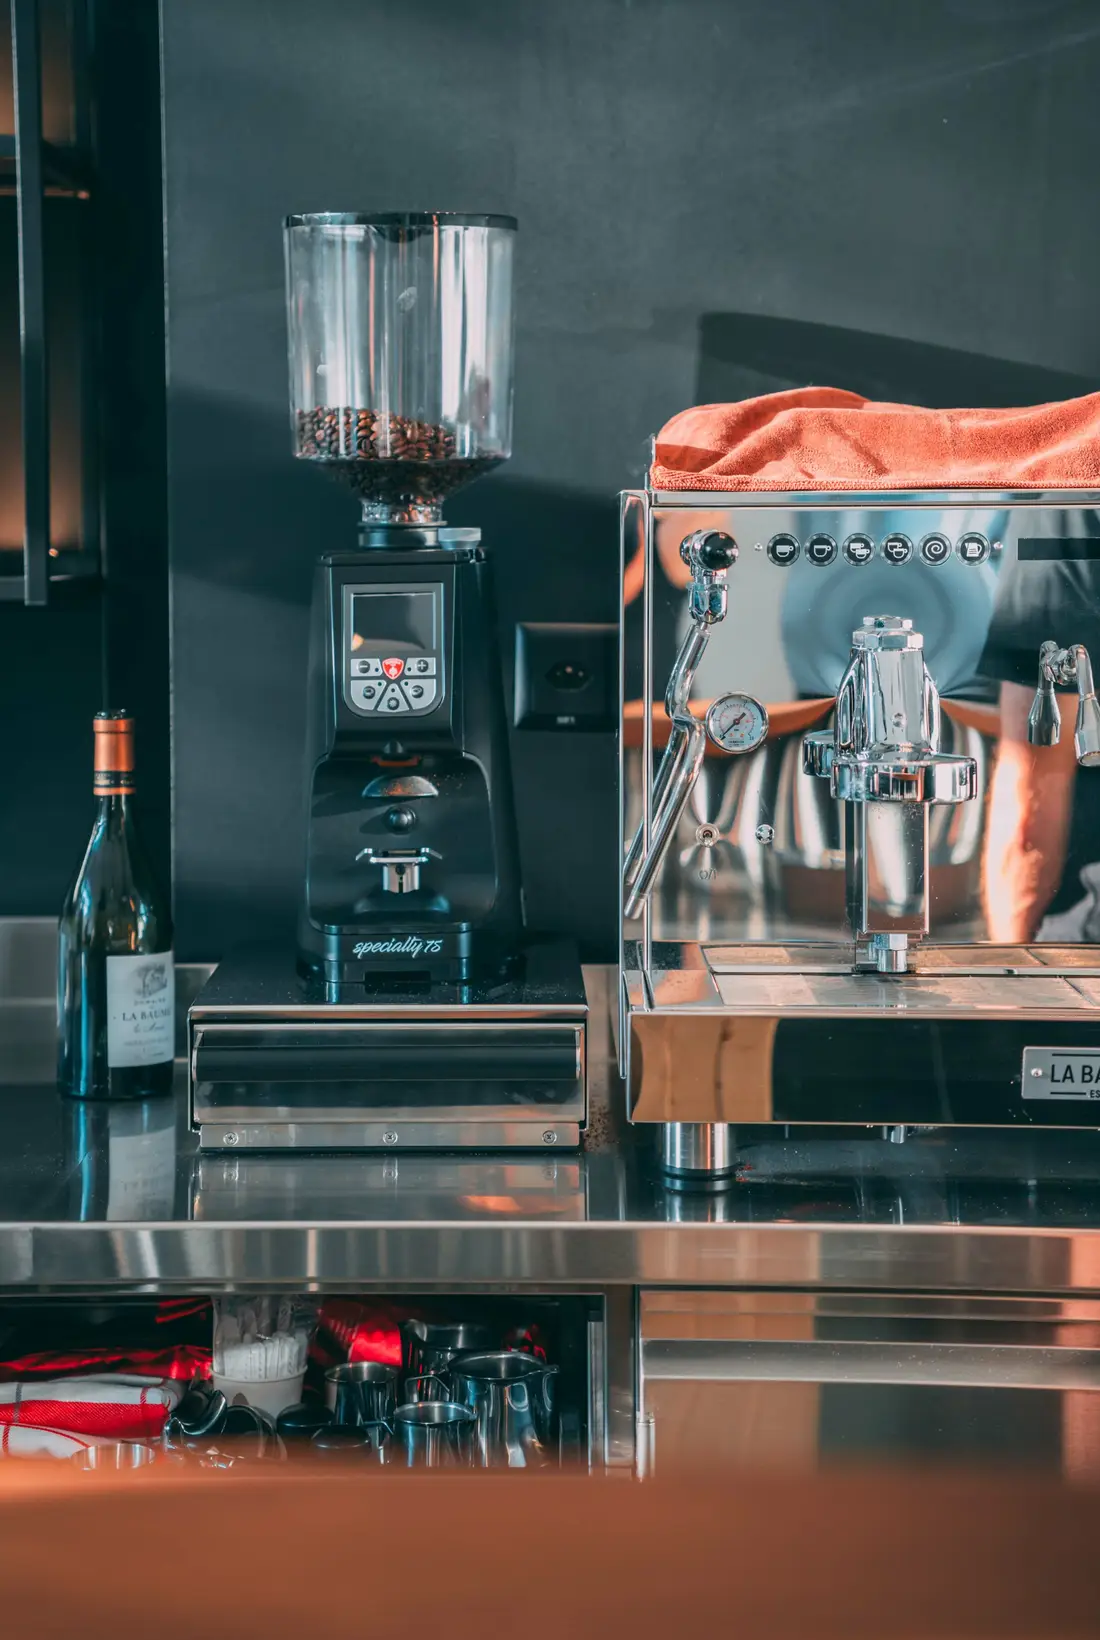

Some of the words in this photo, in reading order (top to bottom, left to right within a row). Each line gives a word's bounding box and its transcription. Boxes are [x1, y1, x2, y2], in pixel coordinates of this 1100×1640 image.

[352, 936, 422, 959] specialty
[424, 939, 443, 953] 75
[122, 1012, 137, 1021] LA
[1050, 1064, 1075, 1083] LA
